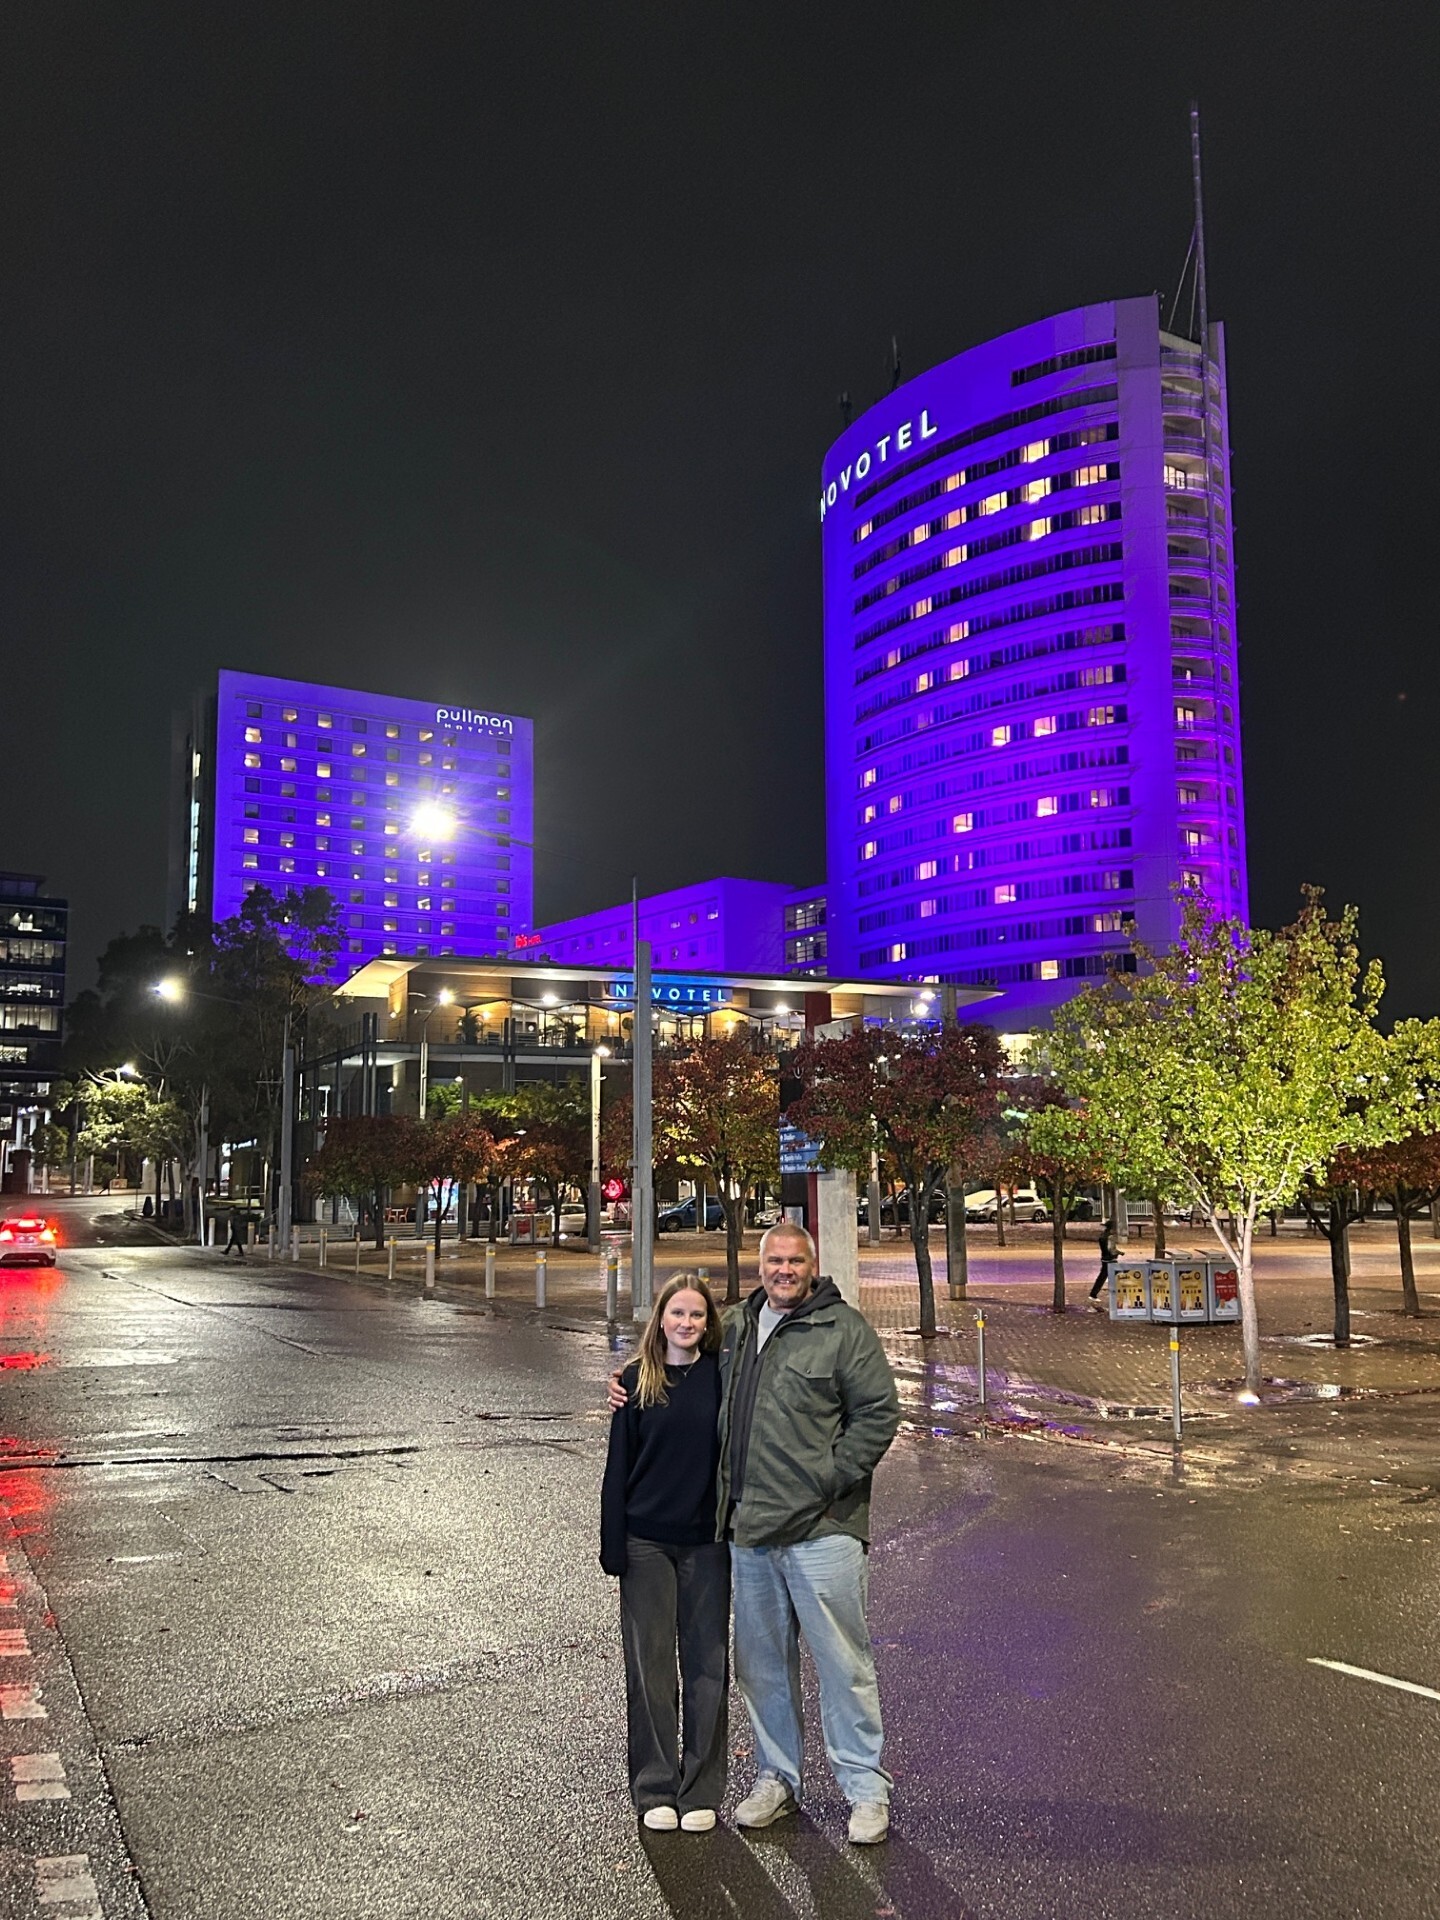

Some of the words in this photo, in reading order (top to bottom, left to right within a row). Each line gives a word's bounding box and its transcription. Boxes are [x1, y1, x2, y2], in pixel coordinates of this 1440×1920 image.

[820, 409, 938, 523] NOVOTEL
[436, 709, 513, 734] pullman
[615, 984, 726, 1002] NVOTEL
